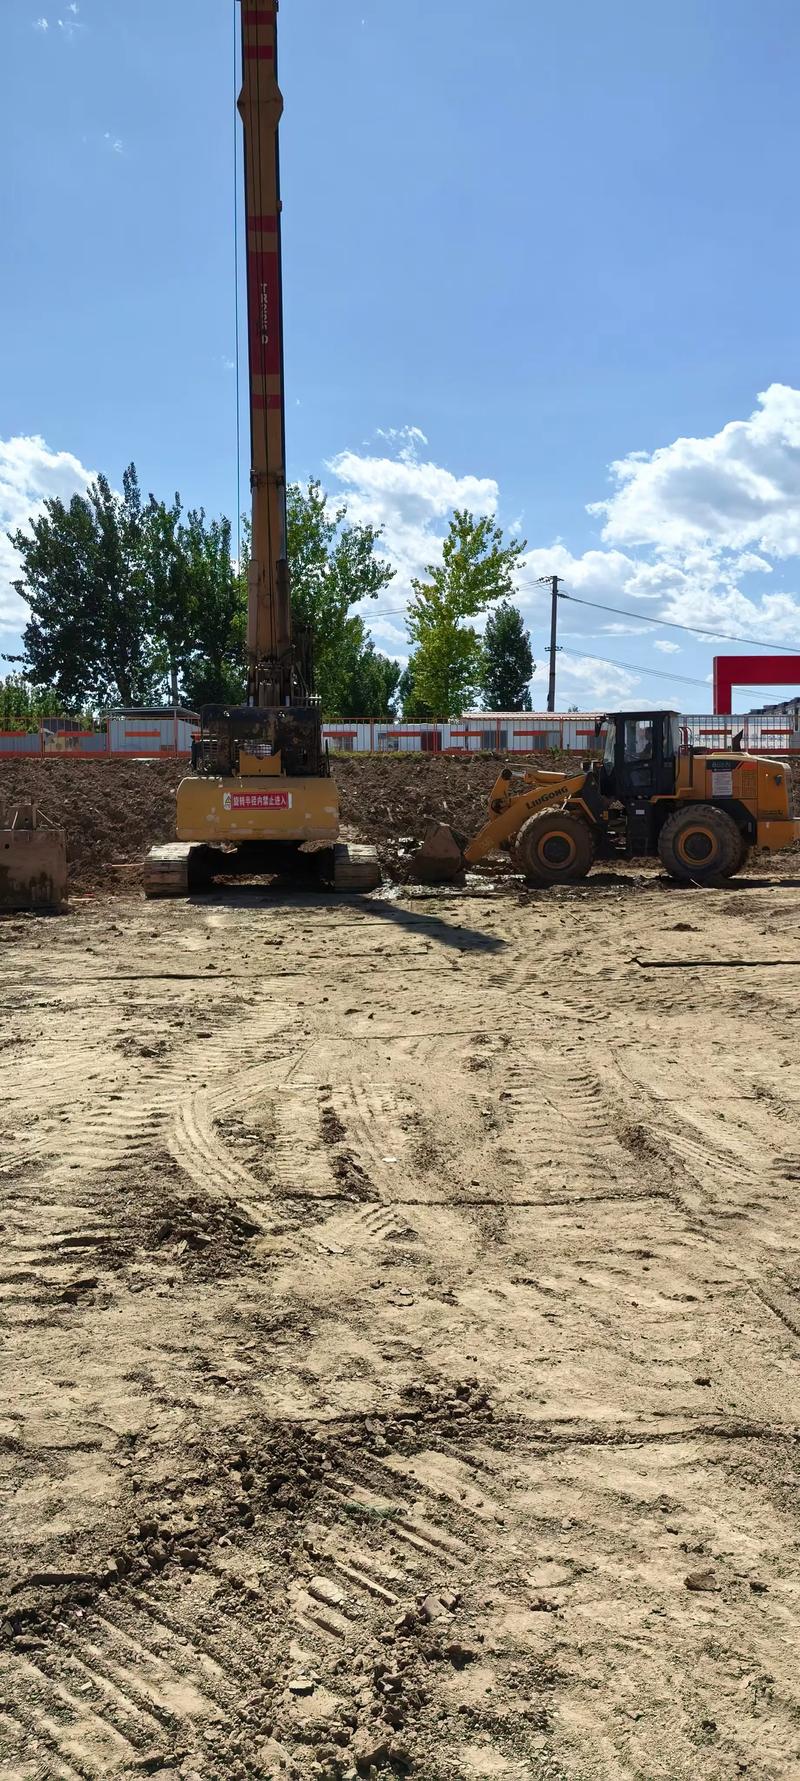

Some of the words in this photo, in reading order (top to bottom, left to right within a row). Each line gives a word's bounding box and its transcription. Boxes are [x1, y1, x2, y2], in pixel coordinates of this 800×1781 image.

[233, 795, 287, 807] 旋转半径内禁止进入
[526, 786, 568, 809] LIUGONG
